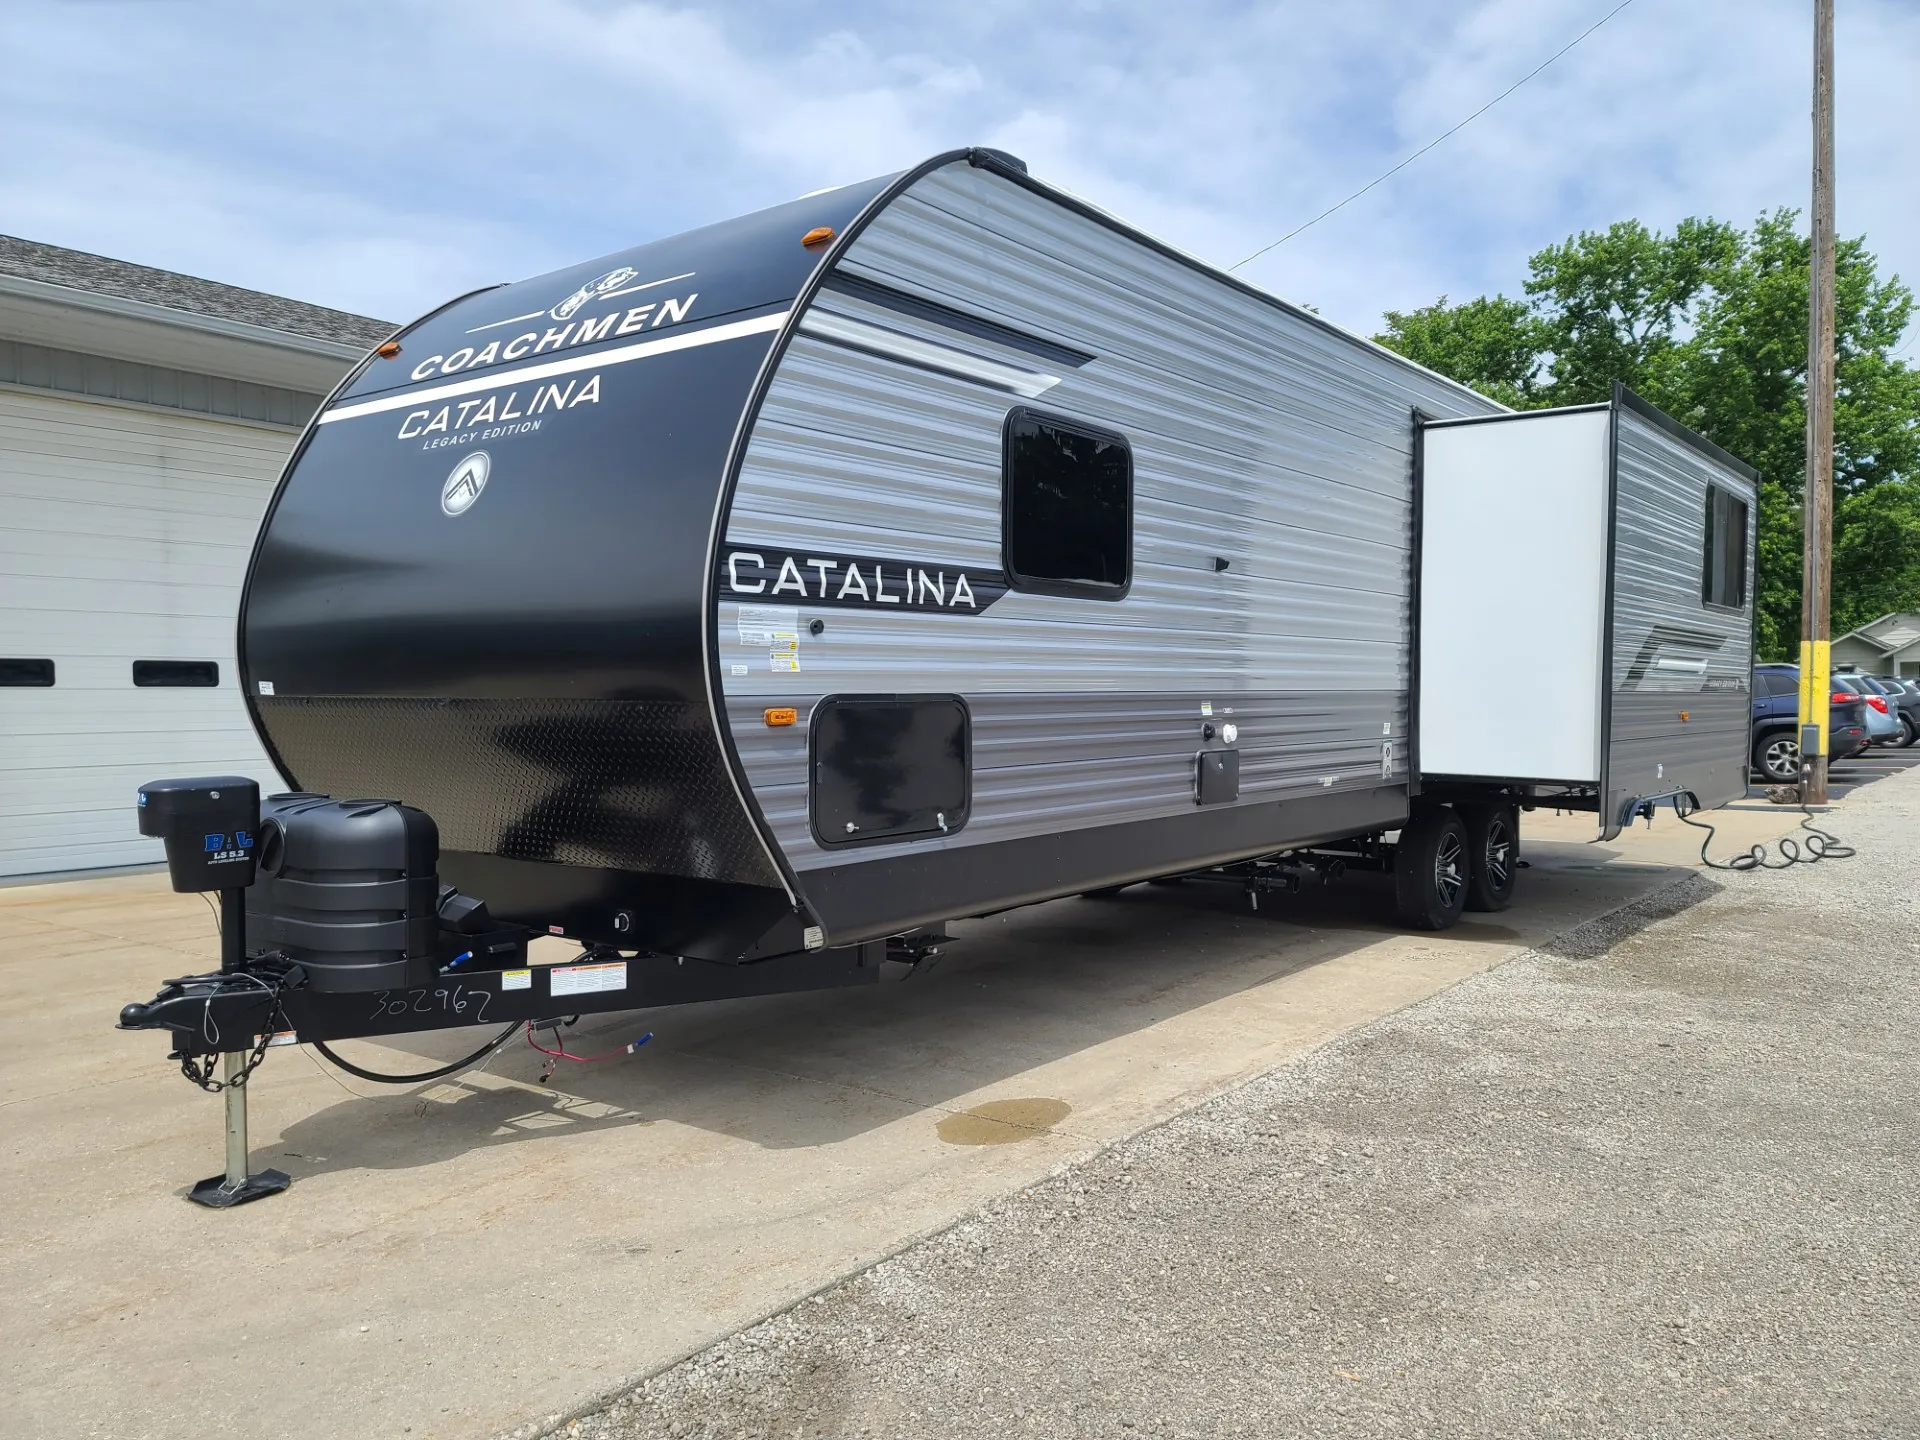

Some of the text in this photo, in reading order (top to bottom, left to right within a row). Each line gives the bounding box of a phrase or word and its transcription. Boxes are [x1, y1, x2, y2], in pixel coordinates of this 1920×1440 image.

[411, 293, 698, 381] COACHMEN
[397, 374, 601, 440] CATALINA
[423, 419, 542, 450] LEGACY EDITION
[728, 551, 976, 608] CATALINA
